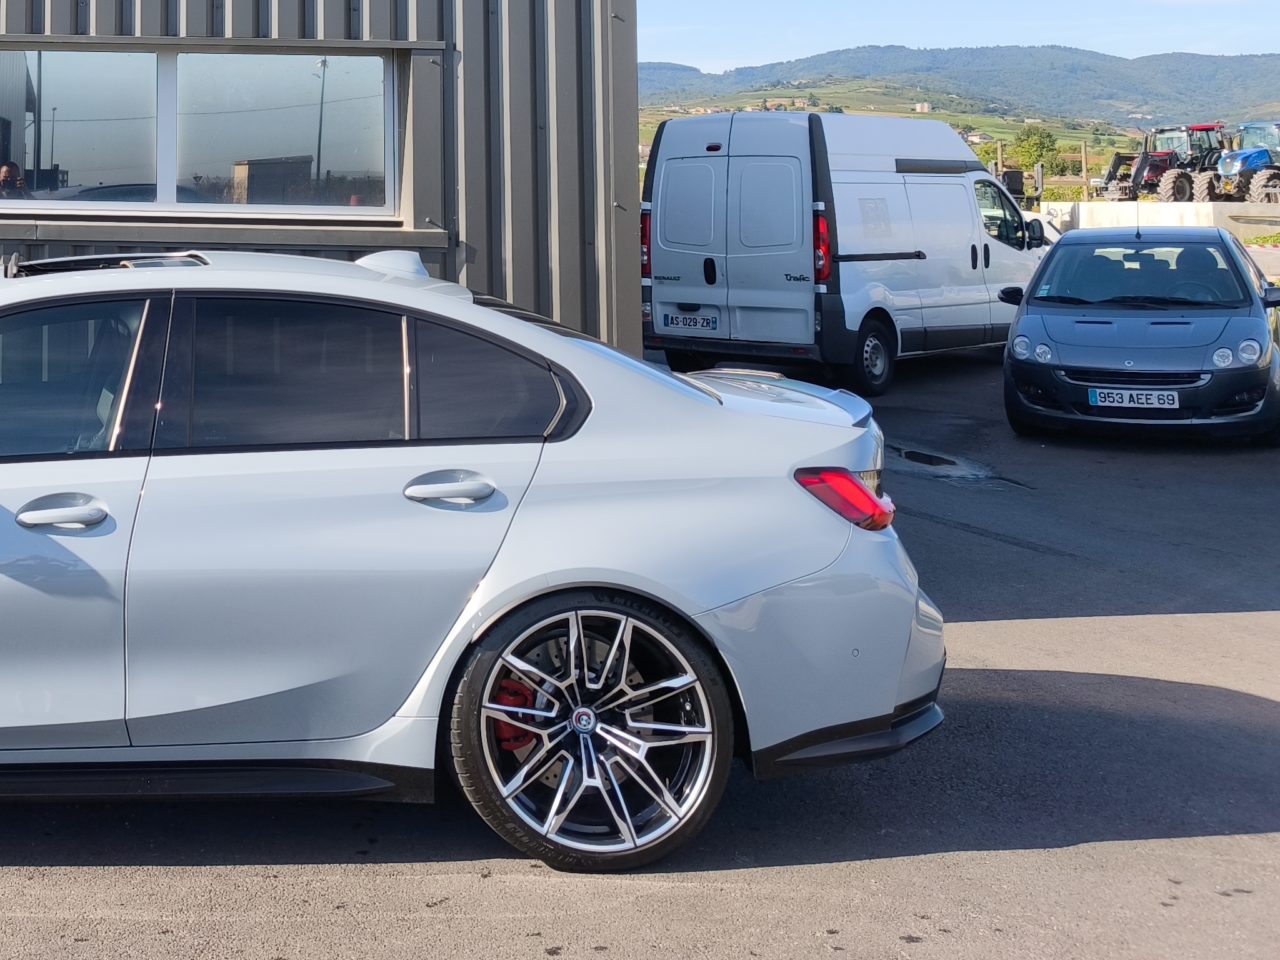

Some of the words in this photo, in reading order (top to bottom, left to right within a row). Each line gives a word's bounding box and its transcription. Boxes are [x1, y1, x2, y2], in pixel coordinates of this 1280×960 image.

[784, 273, 811, 283] Trafic
[669, 315, 711, 328] AS-029-ZR
[1098, 391, 1124, 404] 953
[1128, 393, 1153, 405] AEE
[1157, 393, 1175, 406] 69
